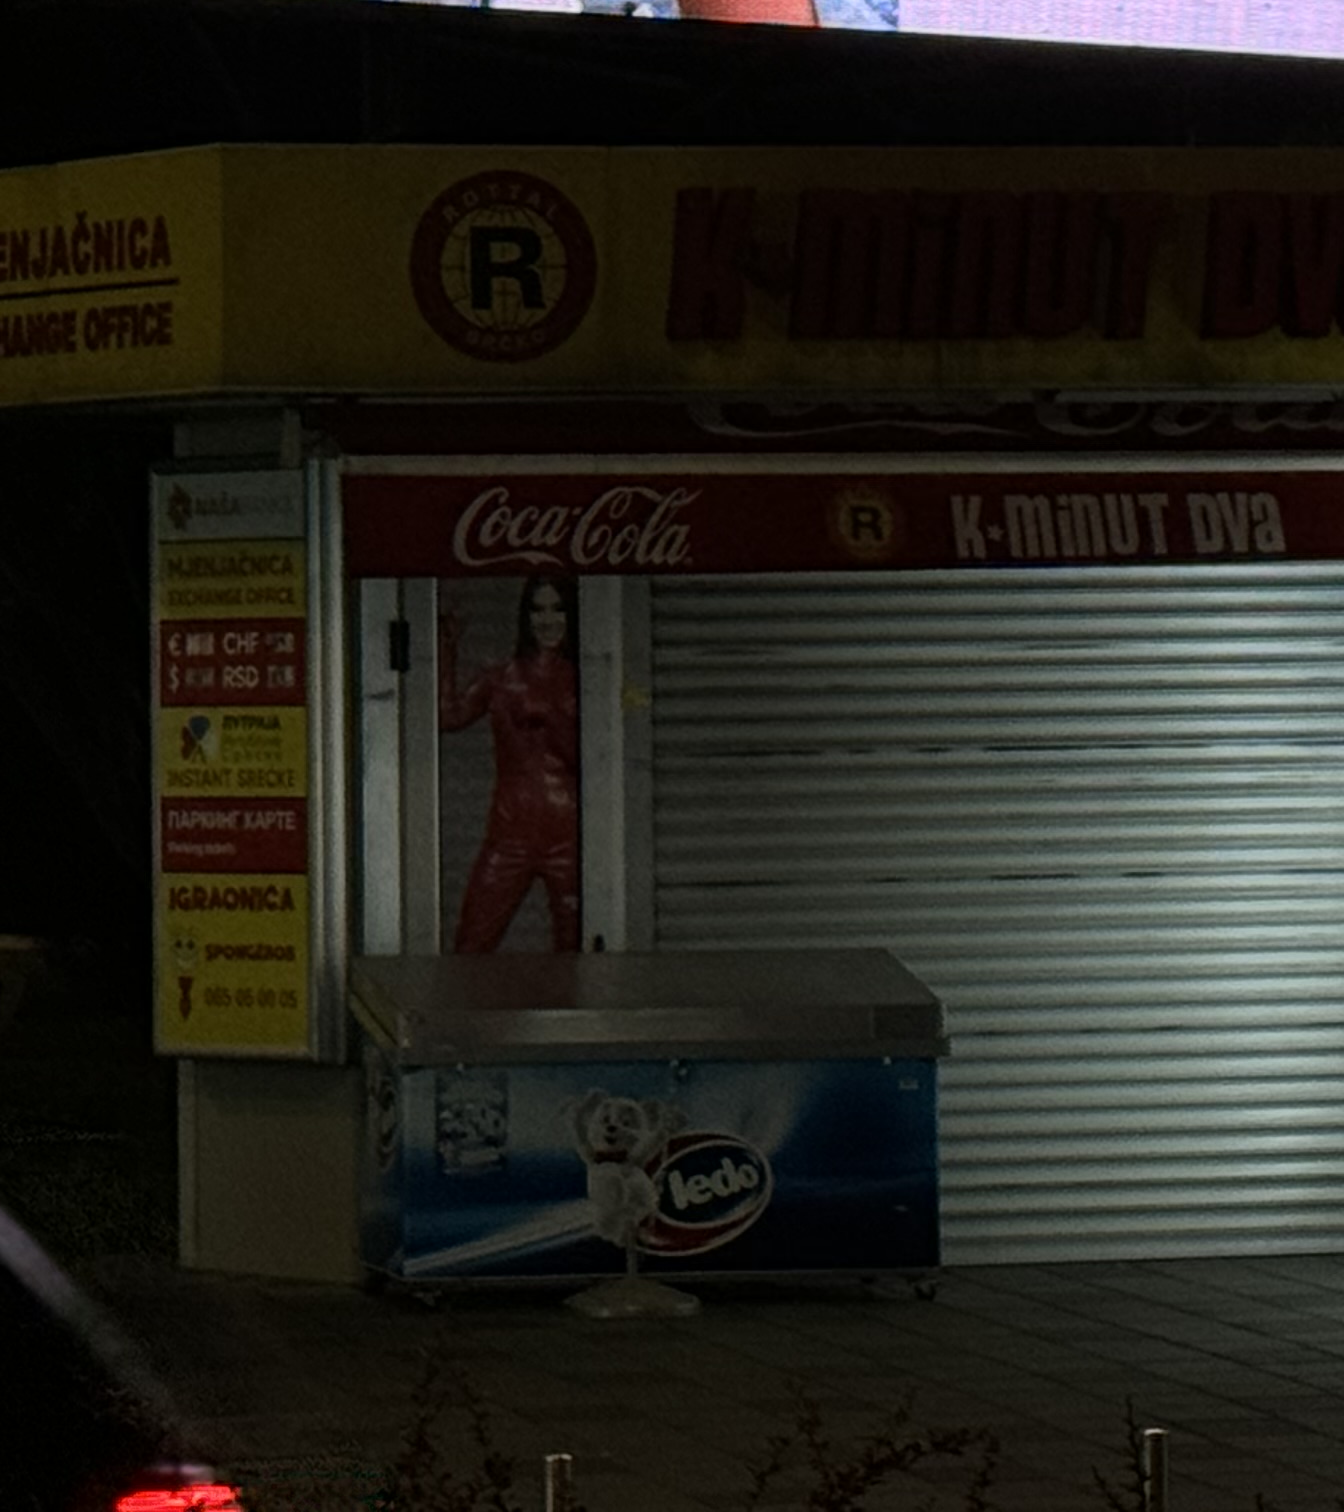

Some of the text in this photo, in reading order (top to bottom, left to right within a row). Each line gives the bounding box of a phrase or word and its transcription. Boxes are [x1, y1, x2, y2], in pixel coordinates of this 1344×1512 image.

[471, 227, 546, 309] R
[84, 301, 174, 350] OFFICE
[453, 484, 704, 569] Coca-Cola
[167, 550, 294, 578] MJENJAČNICA
[167, 588, 296, 607] EXCHANGE OFFICE
[221, 631, 260, 655] CHF
[168, 663, 181, 694] $
[221, 664, 260, 689] RSD
[166, 767, 233, 789] INSTANT
[167, 809, 297, 832] ПАРКИНГ КАРТЕ
[168, 884, 297, 912] IGRAONICA
[667, 1156, 758, 1212] ledo
